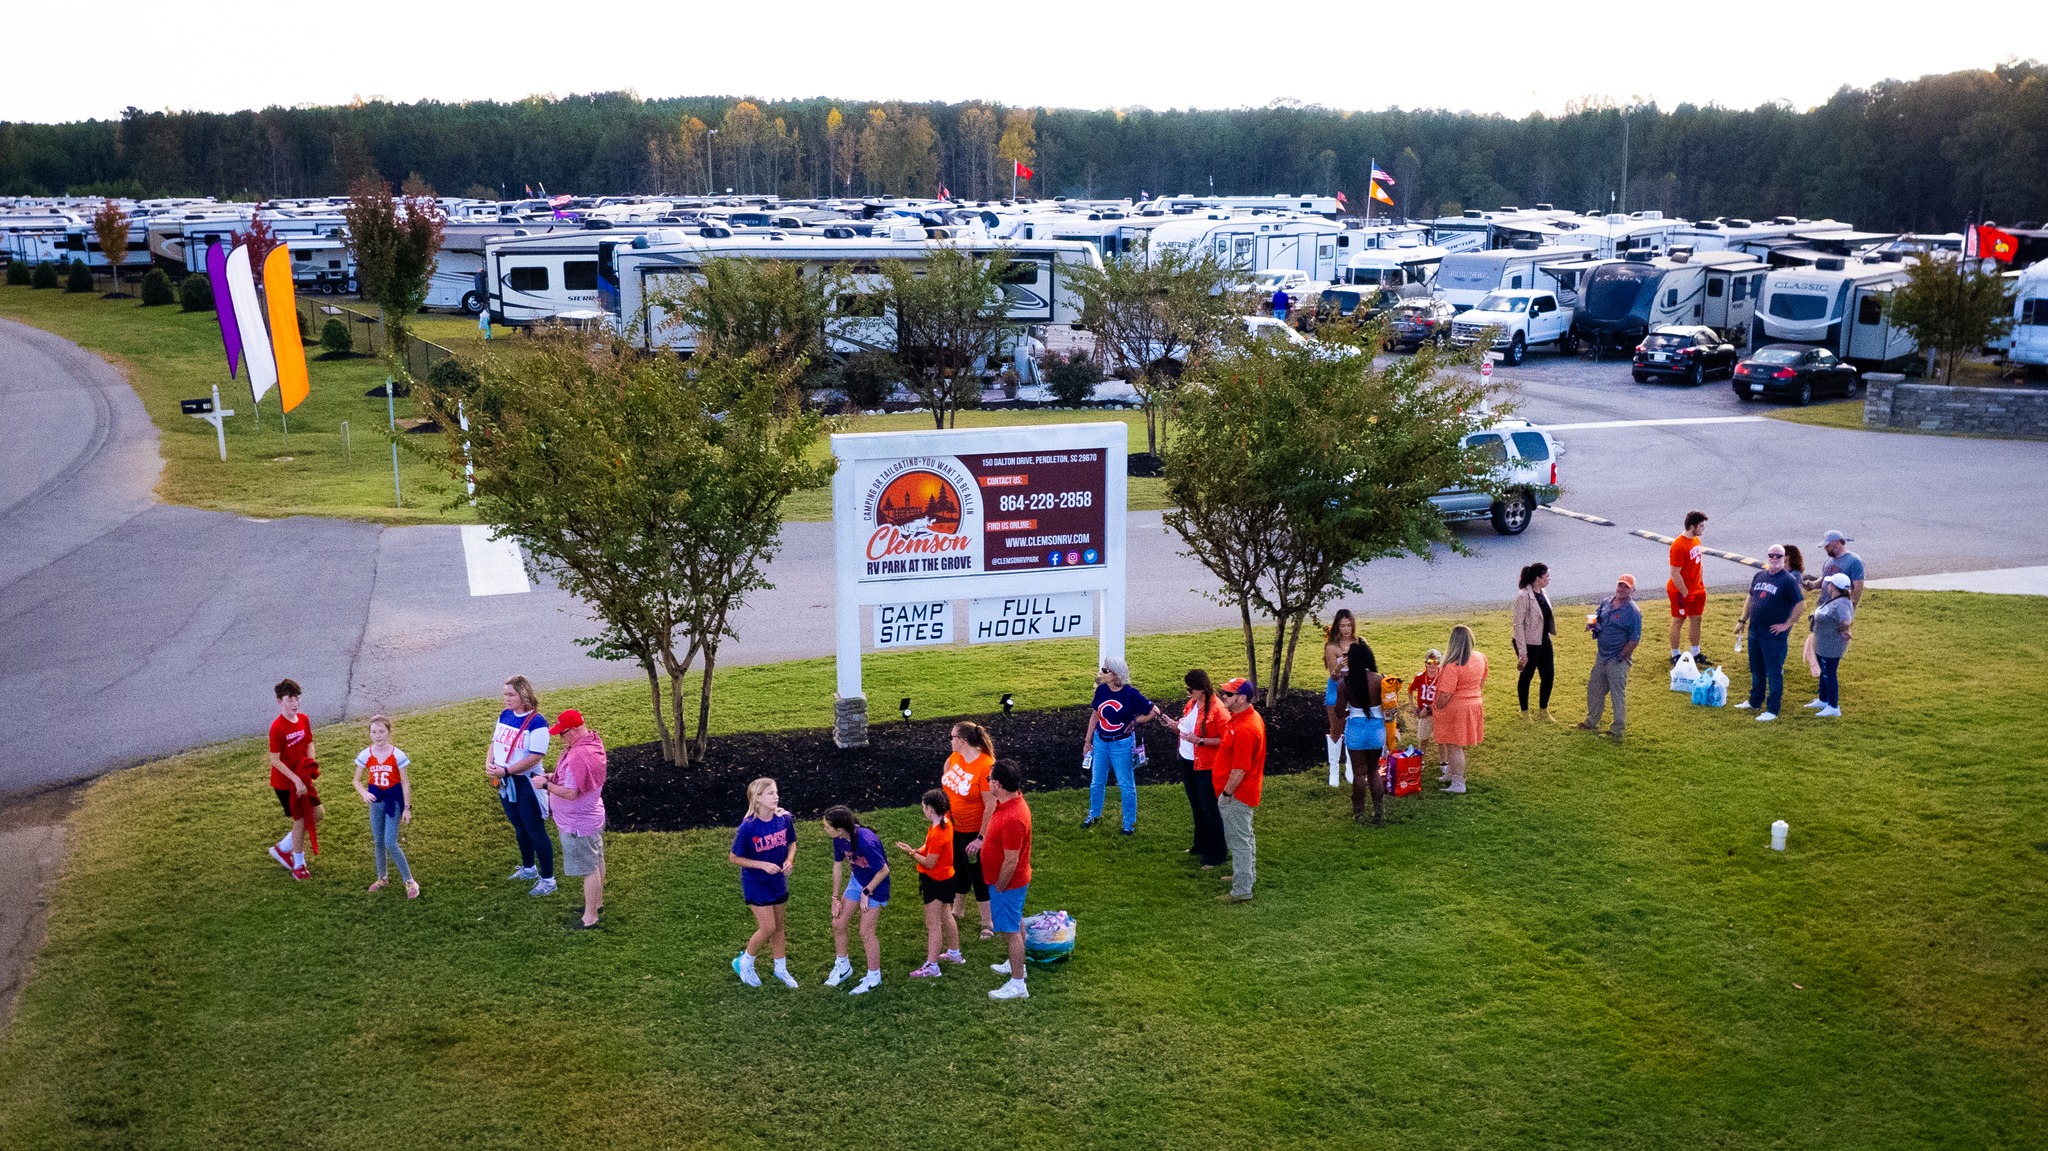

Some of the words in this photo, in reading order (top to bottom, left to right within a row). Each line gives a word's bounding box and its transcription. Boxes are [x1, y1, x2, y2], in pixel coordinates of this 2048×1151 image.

[1774, 281, 1829, 292] CLASSIC
[982, 458, 993, 467] 150
[994, 457, 1016, 467] DALTON
[1016, 456, 1035, 466] DRIVE,
[1035, 454, 1070, 465] PENDLETON,
[1070, 454, 1078, 462] SC
[1078, 453, 1097, 462] 29670
[936, 461, 957, 477] WANT
[872, 478, 883, 490] OR
[954, 474, 964, 484] TO
[986, 477, 1012, 486] CONTACT
[1013, 476, 1023, 484] US:
[960, 482, 970, 493] BE
[863, 488, 877, 521] CAMPING
[964, 493, 974, 506] ALL
[1000, 491, 1092, 512] 864-228-2858
[987, 522, 1000, 531] FIND
[1001, 521, 1009, 530] US
[1009, 520, 1032, 530] ONLINE:
[866, 526, 972, 560] Clemson
[1005, 533, 1090, 548] WWW.CLEMSONRV.COM
[867, 561, 880, 576] RV
[882, 560, 907, 575] PARK
[908, 558, 920, 573] AT
[921, 557, 939, 572] THE
[941, 556, 972, 570] GROVE
[1753, 582, 1779, 595] CLEMSON
[881, 603, 944, 624] CAMP
[1003, 598, 1056, 617] FULL
[880, 622, 944, 643] SITES
[978, 617, 1040, 638] HOOK
[1052, 615, 1081, 633] UP
[1421, 684, 1436, 701] 16
[1097, 699, 1124, 732] C
[494, 726, 526, 750] CLEMSN
[373, 771, 390, 787] 16
